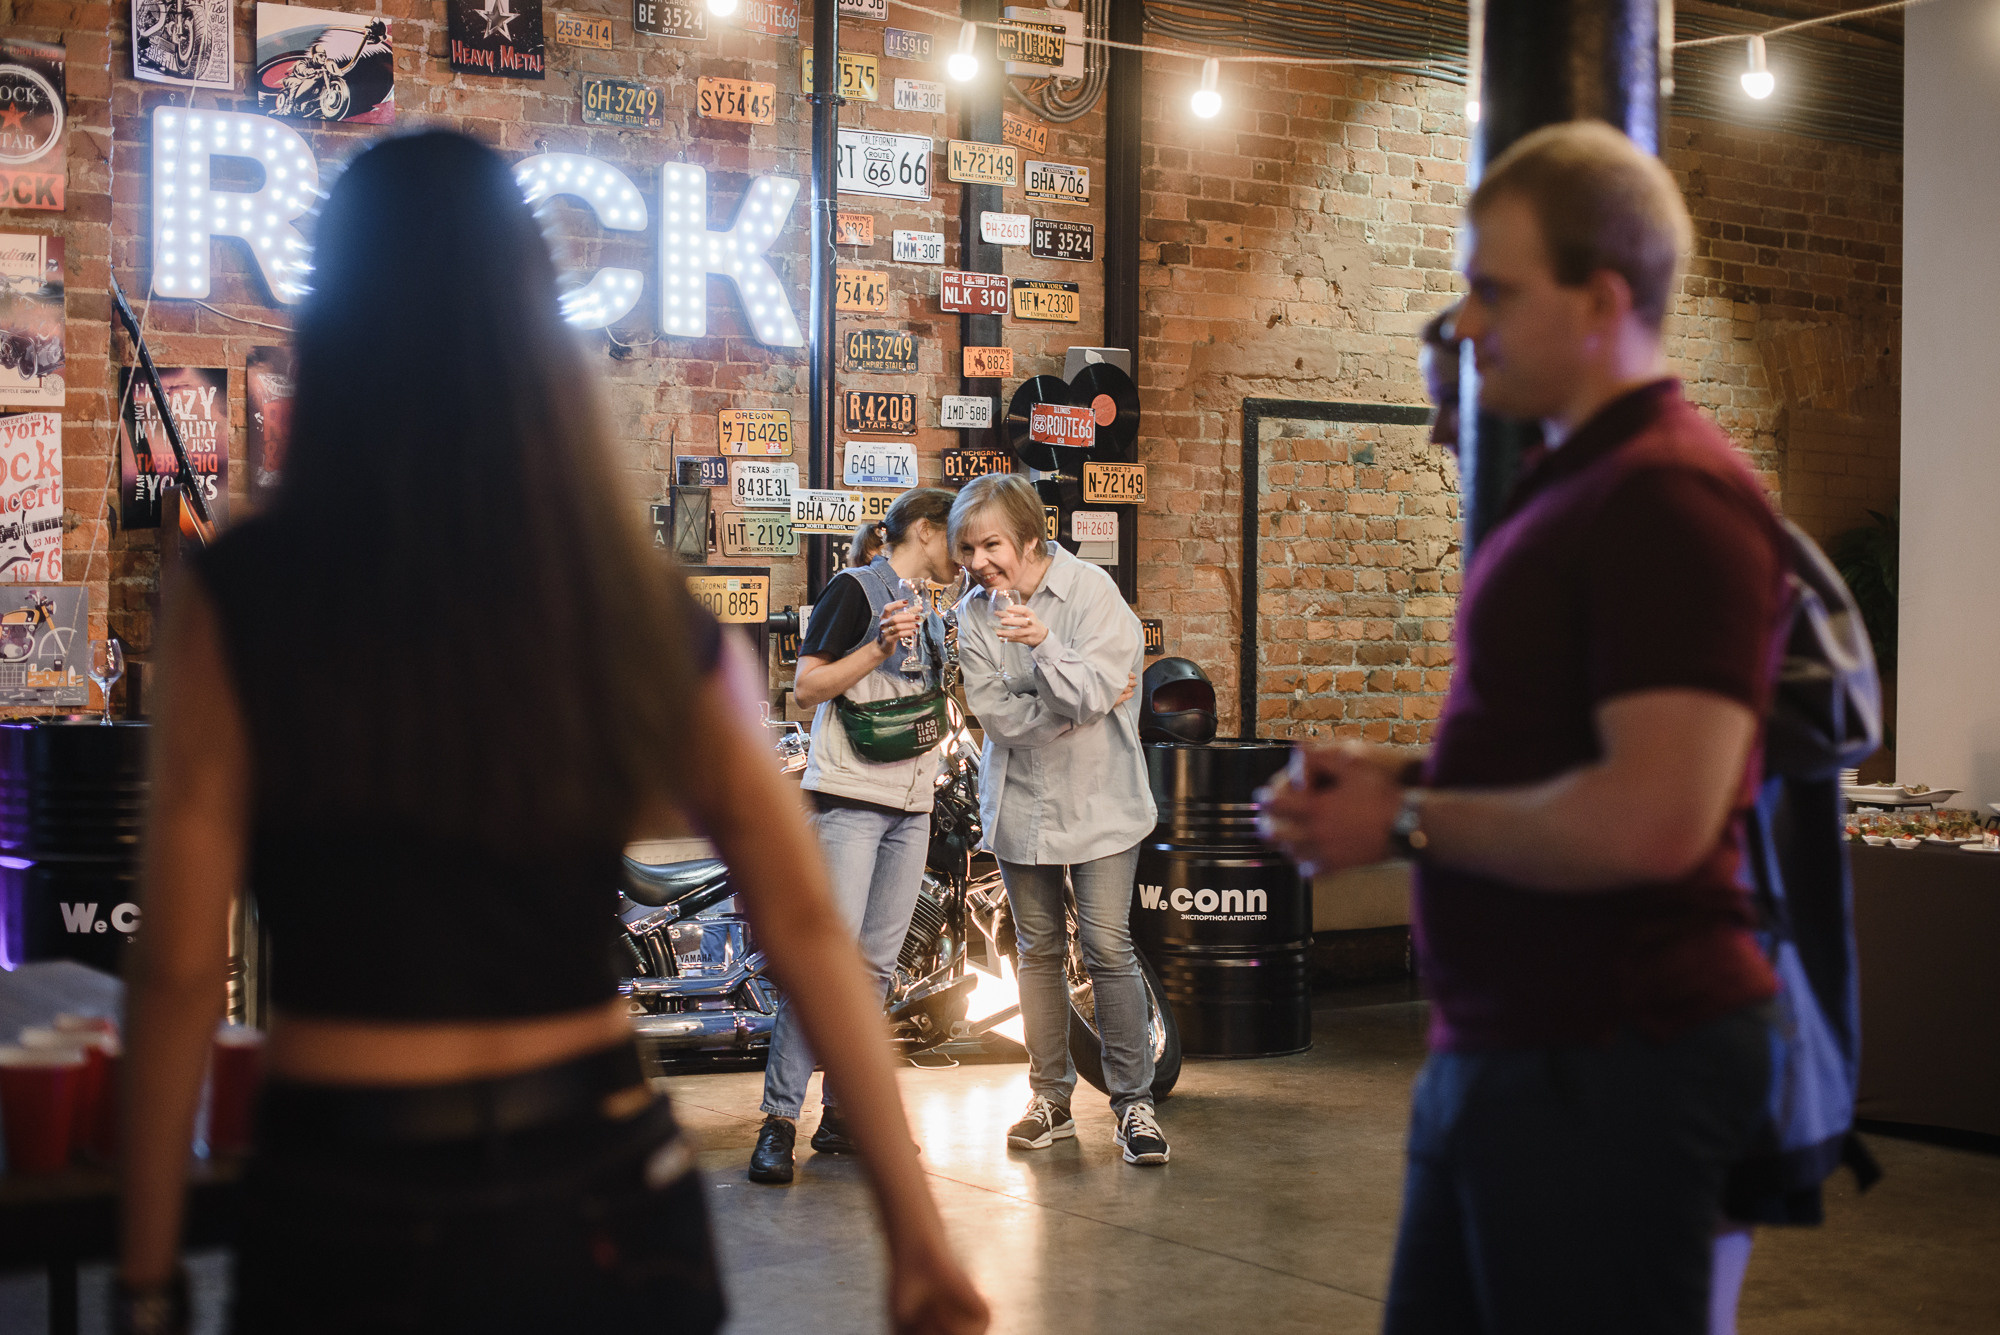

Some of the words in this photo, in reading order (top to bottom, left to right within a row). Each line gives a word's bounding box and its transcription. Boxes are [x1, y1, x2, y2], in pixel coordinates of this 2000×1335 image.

[638, 3, 657, 25] BE
[663, 7, 704, 30] 3524
[557, 19, 610, 41] 258-414
[662, 27, 677, 35] 1971
[999, 33, 1017, 48] NR
[888, 34, 930, 55] 115919
[451, 39, 495, 73] HEAVY
[500, 44, 545, 73] METAL
[601, 113, 623, 123] EMPIRE
[625, 114, 645, 125] STATE
[860, 134, 897, 147] CALIFORNIA
[1003, 119, 1045, 146] 258-414
[868, 151, 890, 160] ROUTE
[953, 150, 1014, 176] N-72149
[868, 161, 891, 182] 66
[899, 151, 927, 186] 66
[1031, 171, 1055, 191] BHA
[1060, 175, 1084, 194] 706
[1034, 221, 1058, 229] SOUTH
[1059, 223, 1092, 233] CAROLINA
[1036, 230, 1052, 249] BE
[1058, 232, 1091, 253] 3524
[944, 286, 972, 305] NLK
[980, 289, 1006, 307] 310
[1046, 282, 1064, 290] YORK
[884, 361, 902, 370] STATE
[986, 355, 1005, 370] 882
[734, 412, 774, 420] OREGON
[858, 421, 904, 430] UTAH-40
[135, 421, 158, 444] MY
[736, 423, 788, 442] 76426
[191, 438, 217, 453] JUST
[736, 443, 743, 452] 7
[747, 465, 770, 473] TEXAS
[851, 454, 876, 475] 649
[886, 455, 910, 475] TZK
[136, 474, 145, 501] THAN
[738, 478, 791, 497] 843E3L
[1088, 472, 1143, 494] N-72149
[797, 501, 824, 521] BHA
[829, 503, 856, 522] 706
[33, 538, 42, 548] 23
[44, 535, 62, 548] May
[727, 524, 794, 545] HT-2193
[12, 547, 62, 582] 1976
[728, 592, 759, 616] 885
[680, 953, 713, 962] YAMAHA
